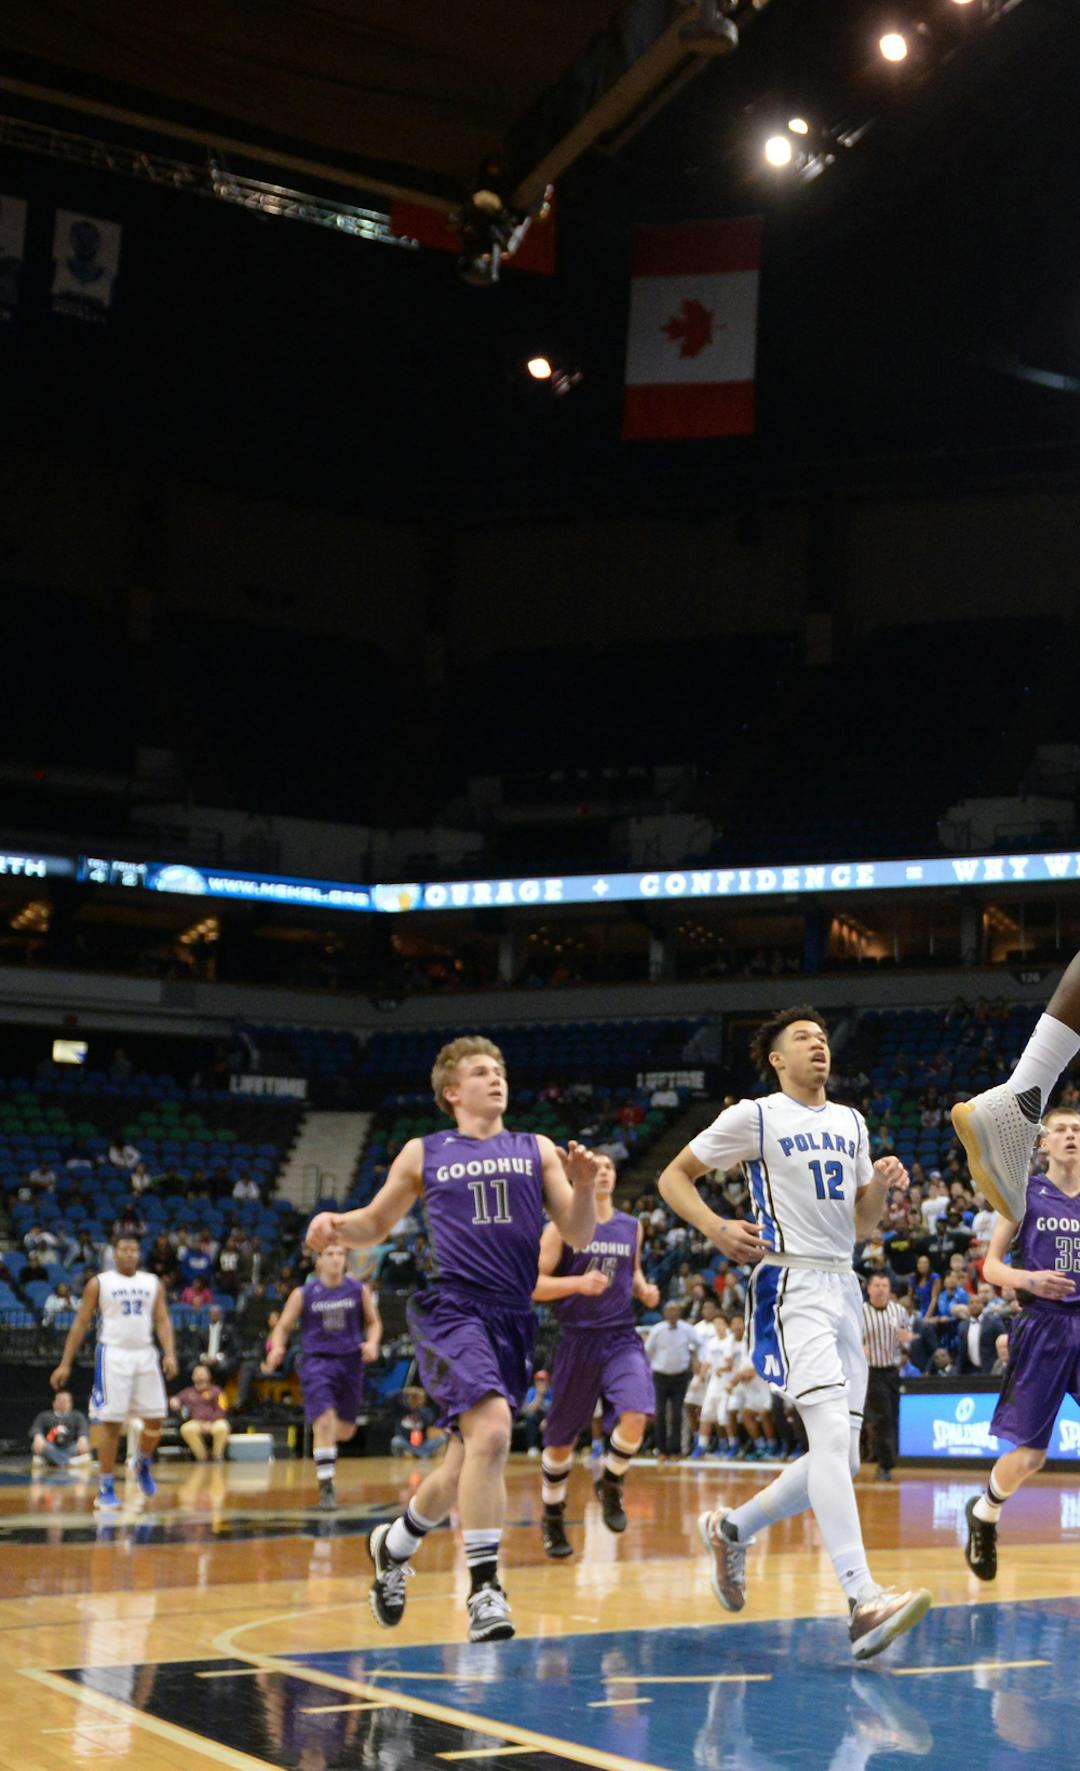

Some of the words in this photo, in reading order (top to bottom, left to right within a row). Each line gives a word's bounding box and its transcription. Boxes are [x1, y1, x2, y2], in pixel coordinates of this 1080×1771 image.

[639, 864, 875, 896] CONFIDENCE
[951, 857, 1029, 881] WHY
[777, 1132, 856, 1159] POLARS
[436, 1157, 533, 1182] GOODHUE
[808, 1160, 845, 1200] 12
[467, 1179, 512, 1224] 11
[573, 1241, 631, 1256] OODHUE
